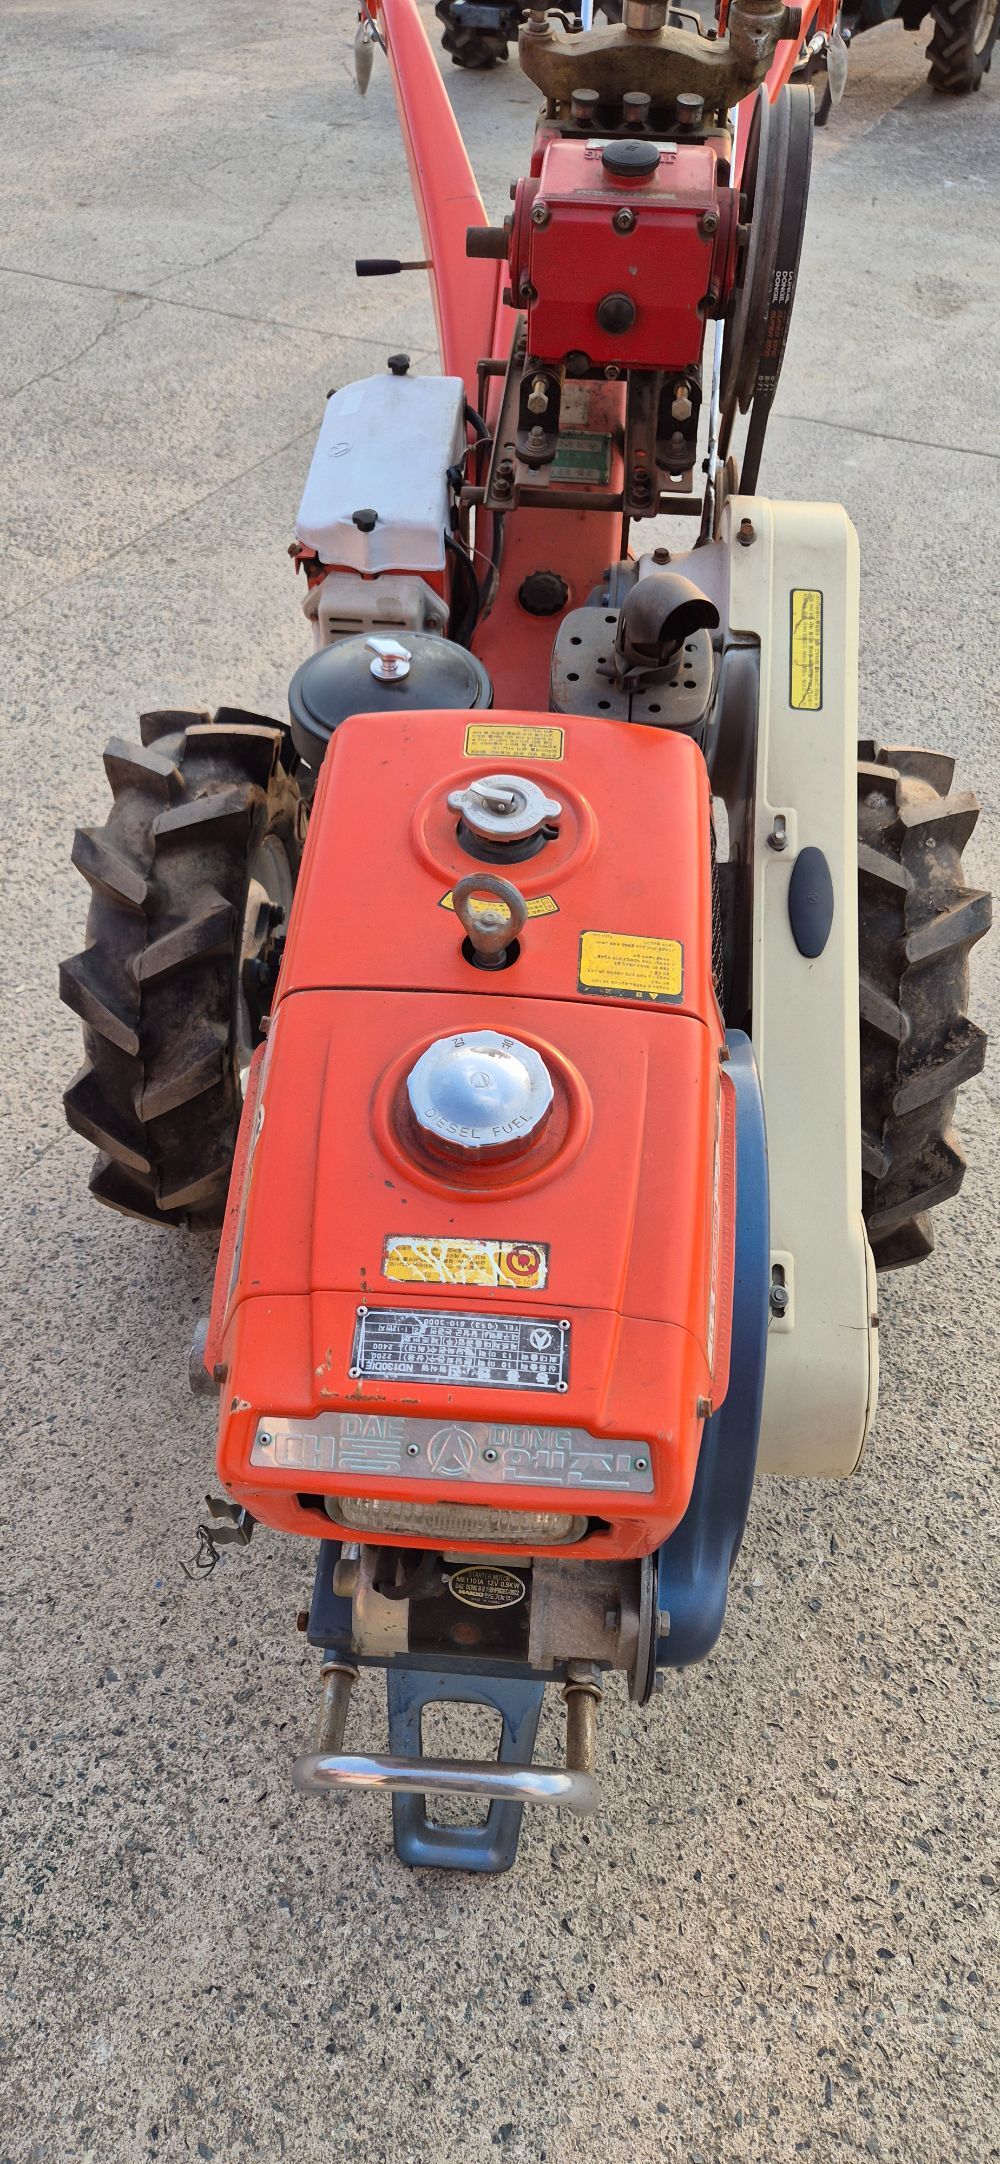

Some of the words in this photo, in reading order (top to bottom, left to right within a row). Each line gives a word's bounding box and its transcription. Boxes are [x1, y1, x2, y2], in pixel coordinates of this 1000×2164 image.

[772, 271, 781, 303] DONGIL
[778, 271, 788, 304] DONGIL
[424, 1107, 481, 1140] DIESEL
[492, 1115, 533, 1138] FUEL
[371, 1352, 392, 1360] 2200
[478, 1360, 496, 1368] 마력
[479, 1350, 496, 1359] 마력
[339, 1415, 405, 1440] DAE
[488, 1424, 573, 1451] DONG
[274, 1433, 403, 1472] 대동
[501, 1449, 632, 1488] 엔진
[458, 1589, 484, 1598] MANDO
